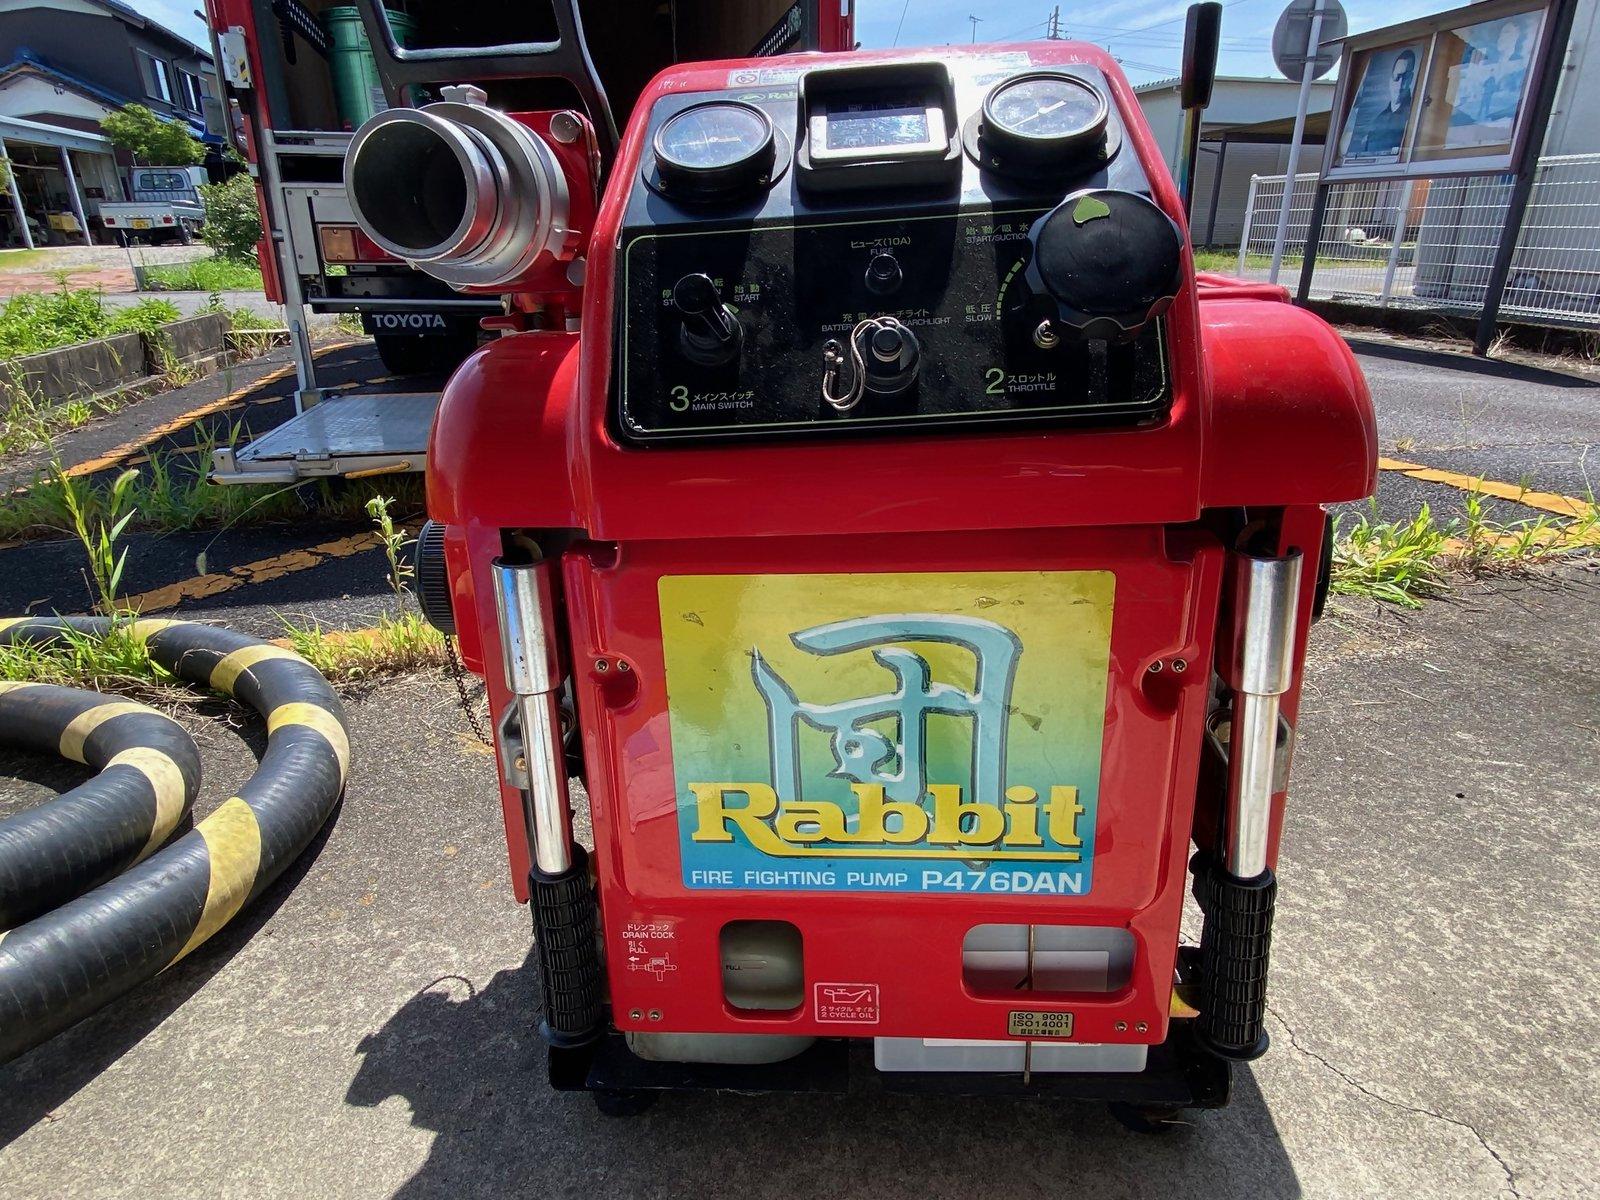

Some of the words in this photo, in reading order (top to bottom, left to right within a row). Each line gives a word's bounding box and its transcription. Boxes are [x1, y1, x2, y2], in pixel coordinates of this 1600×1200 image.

[870, 247, 894, 255] FUSE
[734, 294, 760, 302] START
[372, 314, 446, 328] TOYOTA
[966, 314, 992, 322] SLOW
[986, 368, 1004, 394] 2
[1008, 372, 1056, 384] スロットル
[1008, 382, 1056, 392] THROTTLE
[670, 385, 690, 412] 3
[692, 390, 754, 402] メインスイッチ
[692, 402, 716, 411] MAIN
[718, 400, 753, 410] SWITCH
[688, 782, 1084, 861] Rabbit
[692, 870, 734, 885] FIRE
[744, 871, 836, 886] FIGHTING
[848, 872, 908, 886] PUMP
[921, 870, 1082, 894] P476DAN
[627, 924, 670, 932] ドレンコック
[1013, 1020, 1068, 1028] ISO14001
